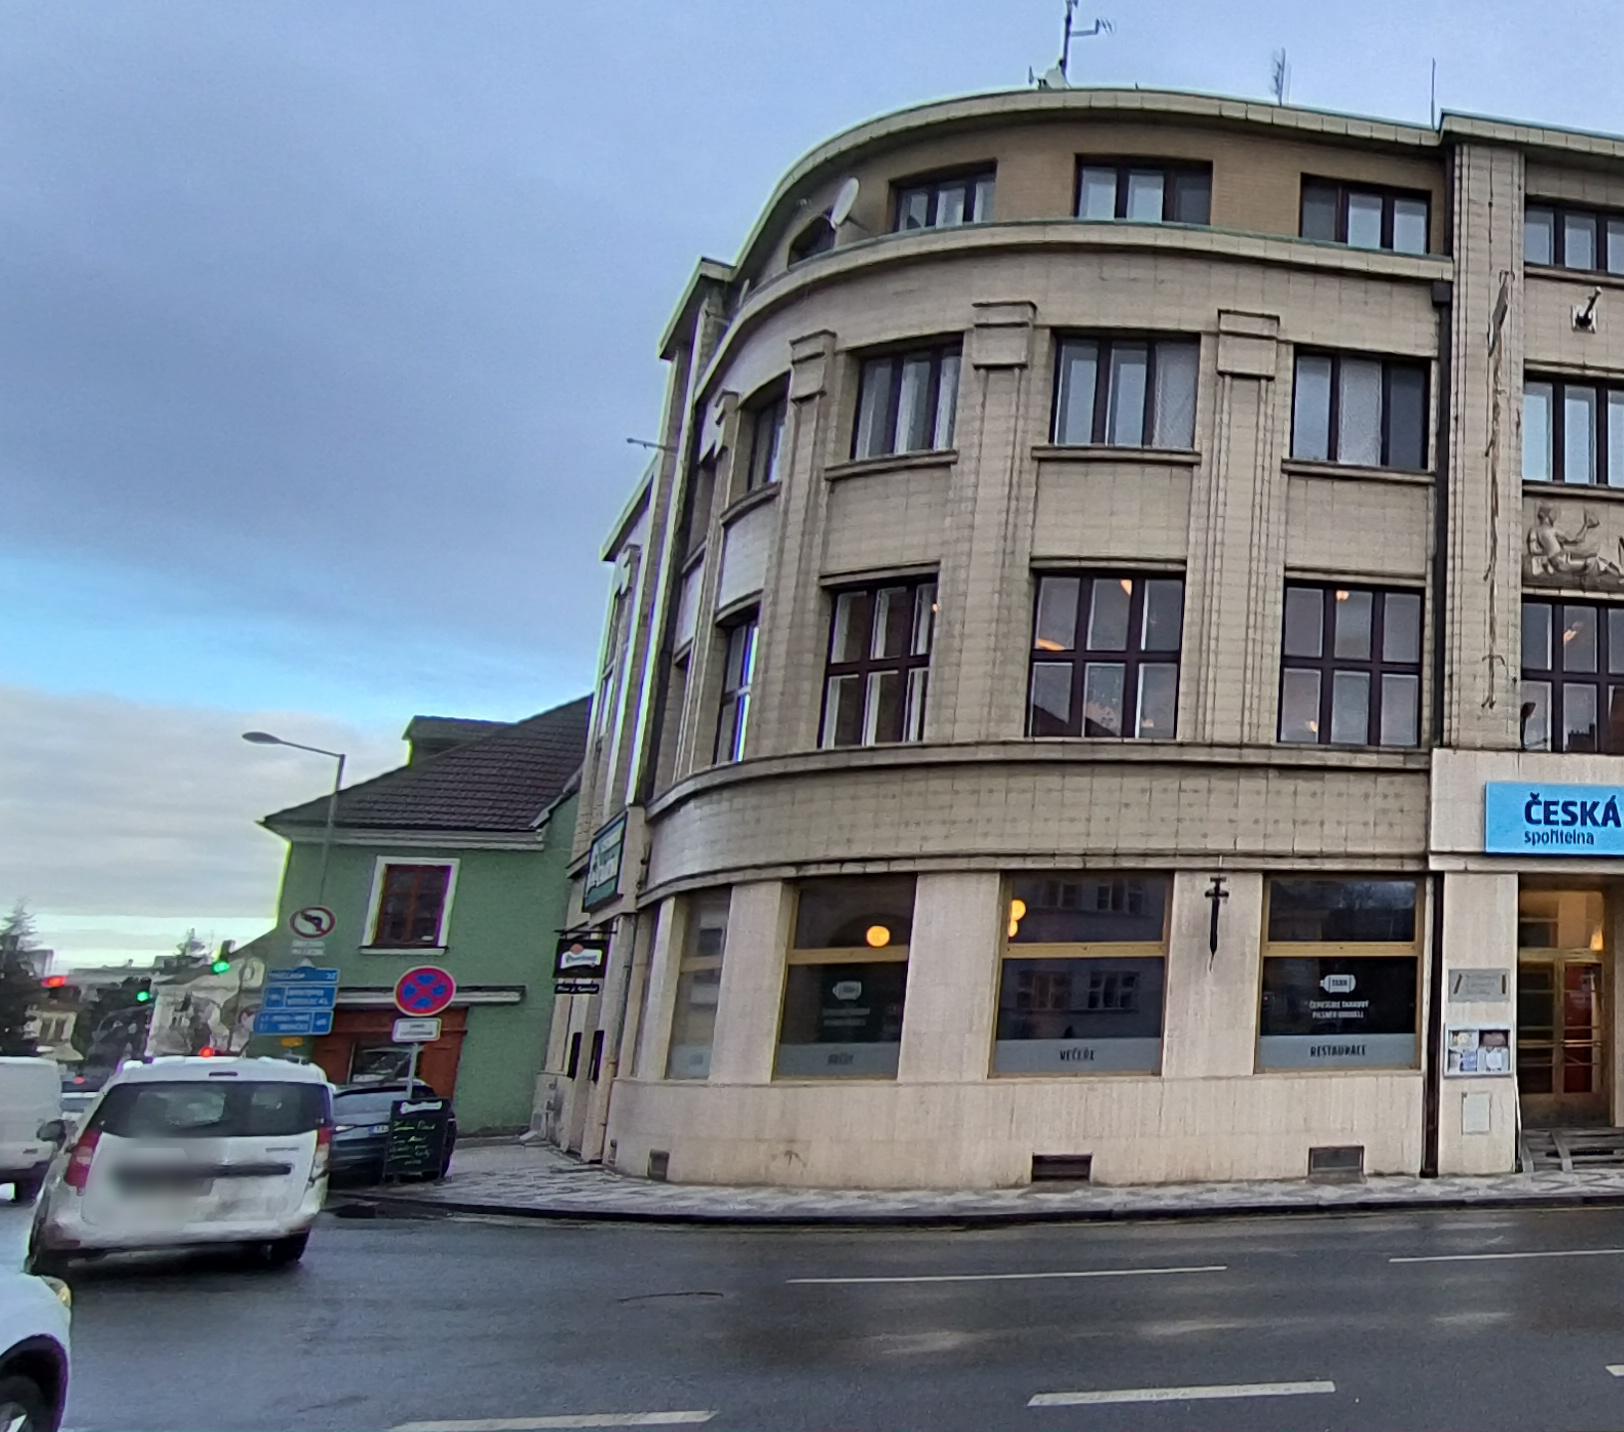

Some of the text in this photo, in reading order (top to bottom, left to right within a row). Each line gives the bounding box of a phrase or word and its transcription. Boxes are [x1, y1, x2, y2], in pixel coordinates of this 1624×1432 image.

[1524, 791, 1622, 828] ČESKÁ
[1524, 829, 1595, 846] spořitelna
[1309, 1044, 1367, 1058] RESTAURACE
